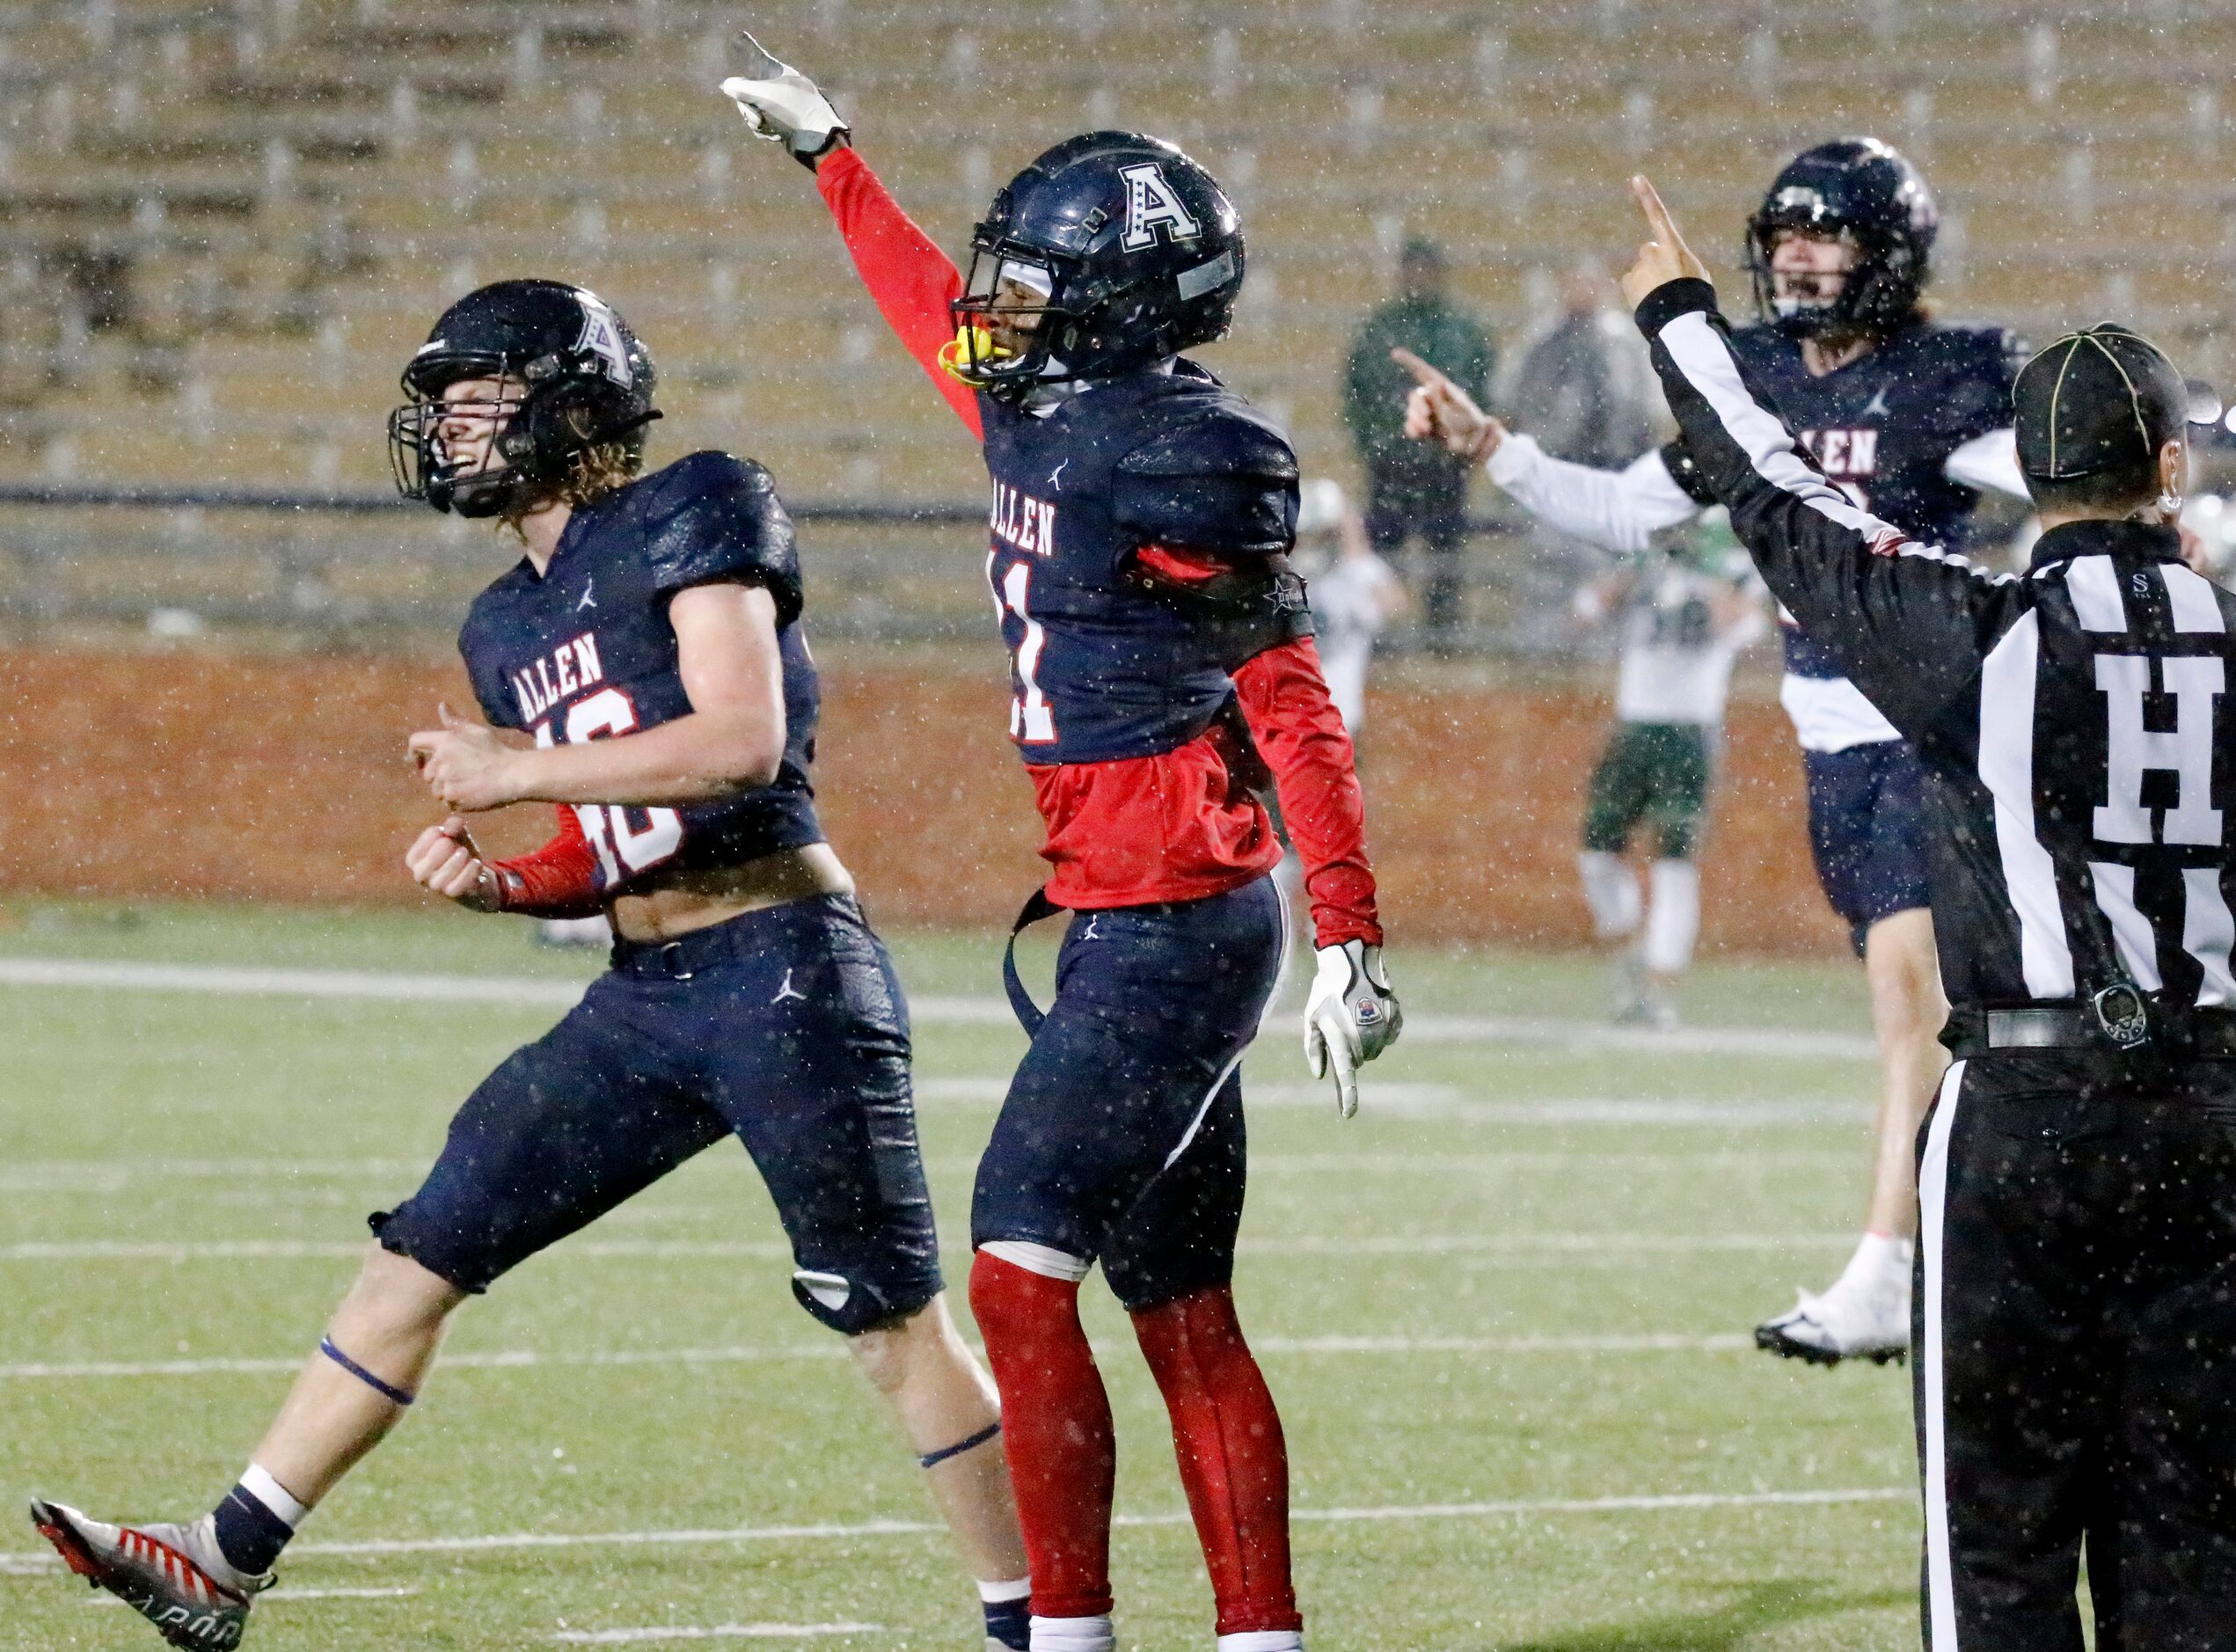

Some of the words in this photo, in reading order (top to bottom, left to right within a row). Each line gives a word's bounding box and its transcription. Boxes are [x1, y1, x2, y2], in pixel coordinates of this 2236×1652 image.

[1118, 163, 1202, 253] A
[568, 303, 633, 391] A
[990, 478, 1055, 556] ALLEN
[513, 632, 603, 724] ALLEN
[2093, 654, 2226, 846] H
